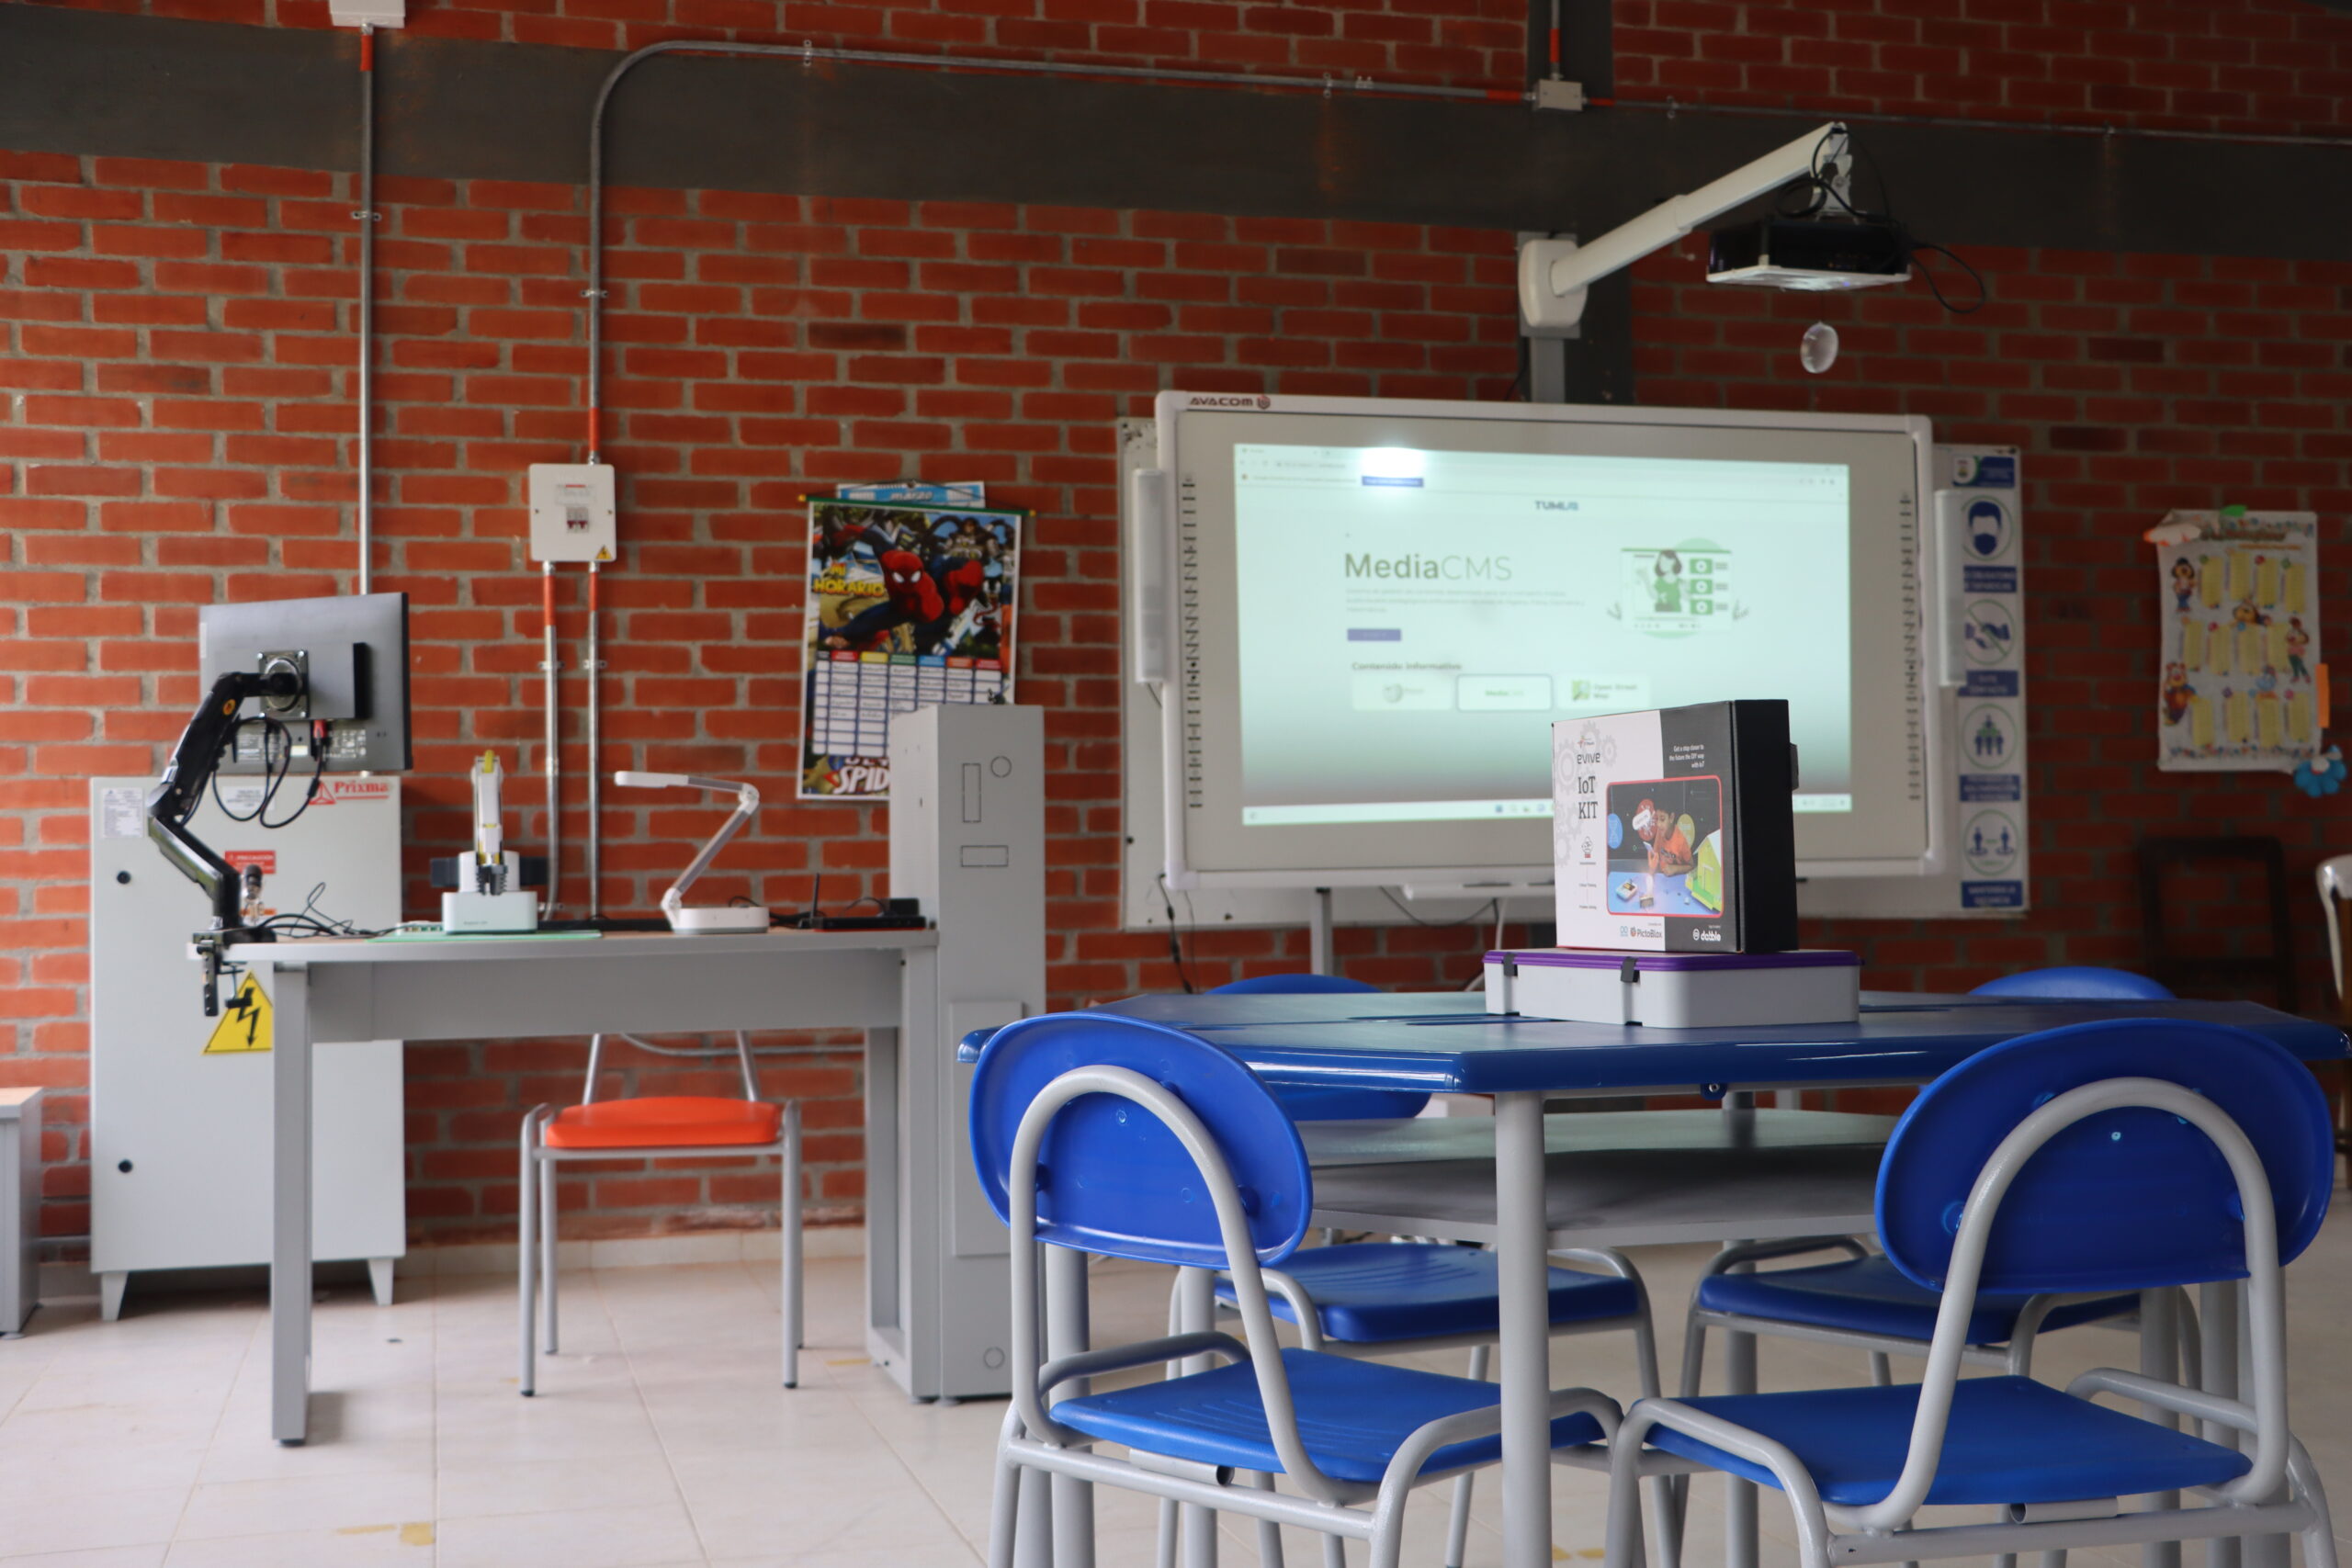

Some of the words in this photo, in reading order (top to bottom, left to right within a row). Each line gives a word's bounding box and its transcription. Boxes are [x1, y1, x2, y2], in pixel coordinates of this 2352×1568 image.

[1190, 397, 1253, 407] AVACOM
[1344, 553, 1512, 581] MediaCMS
[814, 579, 884, 596] HORARIO
[334, 781, 388, 793] Prixma
[1577, 775, 1596, 794] IoT
[1578, 801, 1598, 819] KIT
[1637, 928, 1662, 939] PictoBlox
